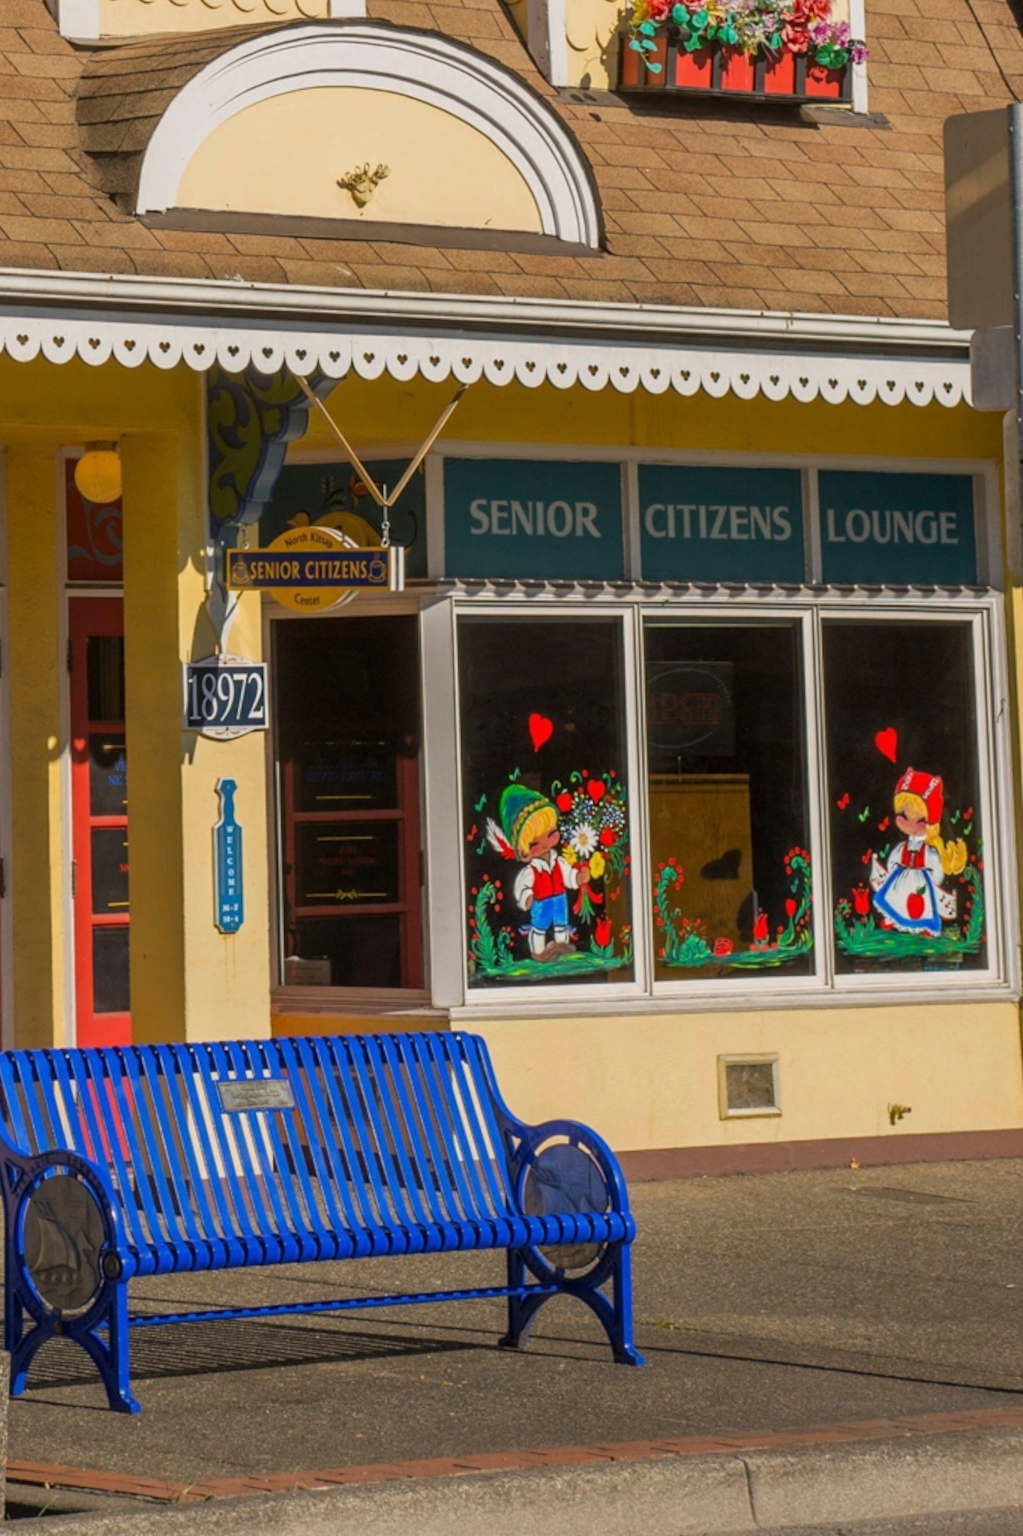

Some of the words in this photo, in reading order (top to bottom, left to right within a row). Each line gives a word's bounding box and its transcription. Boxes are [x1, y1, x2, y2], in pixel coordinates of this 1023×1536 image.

[469, 498, 602, 538] SENIOR
[644, 502, 793, 542] CITIZENS
[826, 509, 960, 545] LOUNGE
[284, 533, 309, 548] North
[310, 533, 334, 549] Kitsap
[250, 560, 301, 580] SENIOR
[304, 560, 369, 580] CITIZENS
[294, 592, 321, 606] Center
[187, 671, 265, 723] 18972
[226, 827, 235, 895] WELCOME
